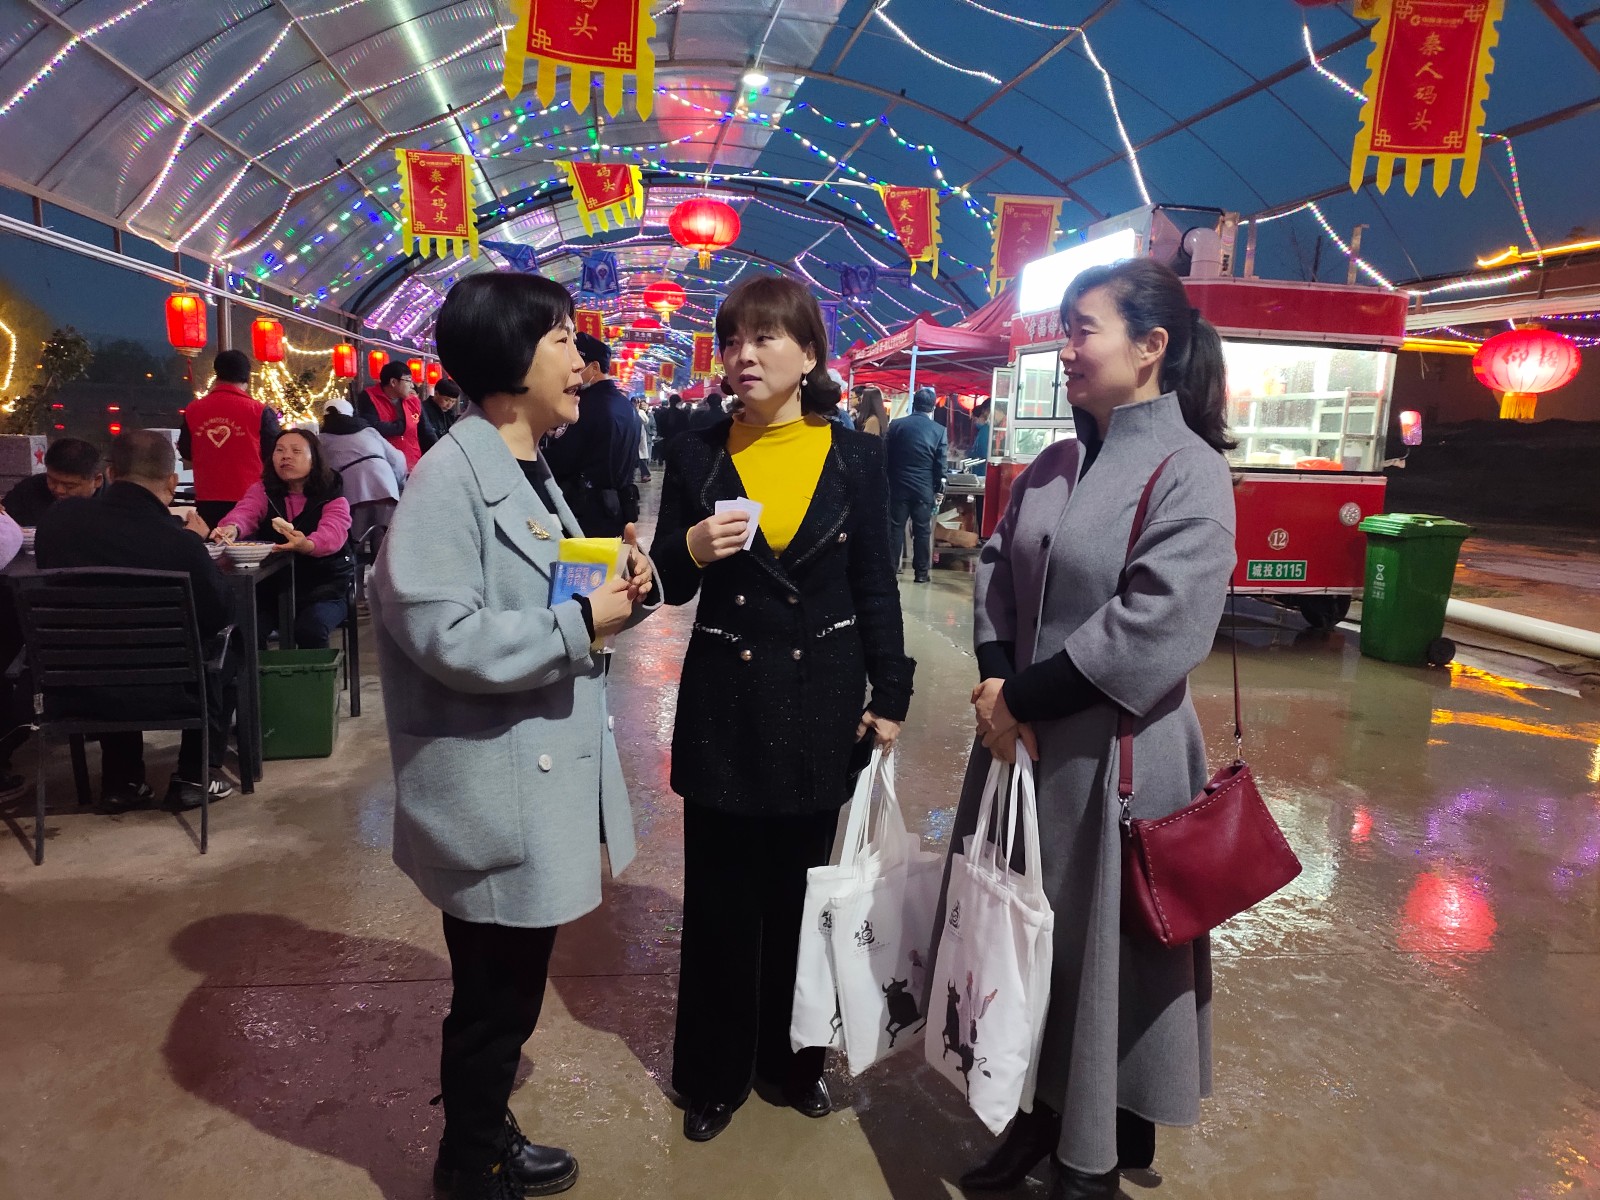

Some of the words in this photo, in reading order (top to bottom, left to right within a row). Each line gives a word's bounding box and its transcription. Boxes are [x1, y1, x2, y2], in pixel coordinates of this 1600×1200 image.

[1408, 31, 1445, 132] 秦人码头
[429, 168, 448, 224] 秦人码头
[1272, 531, 1287, 546] 12
[1252, 563, 1273, 577] 城投
[1275, 563, 1303, 578] 8115
